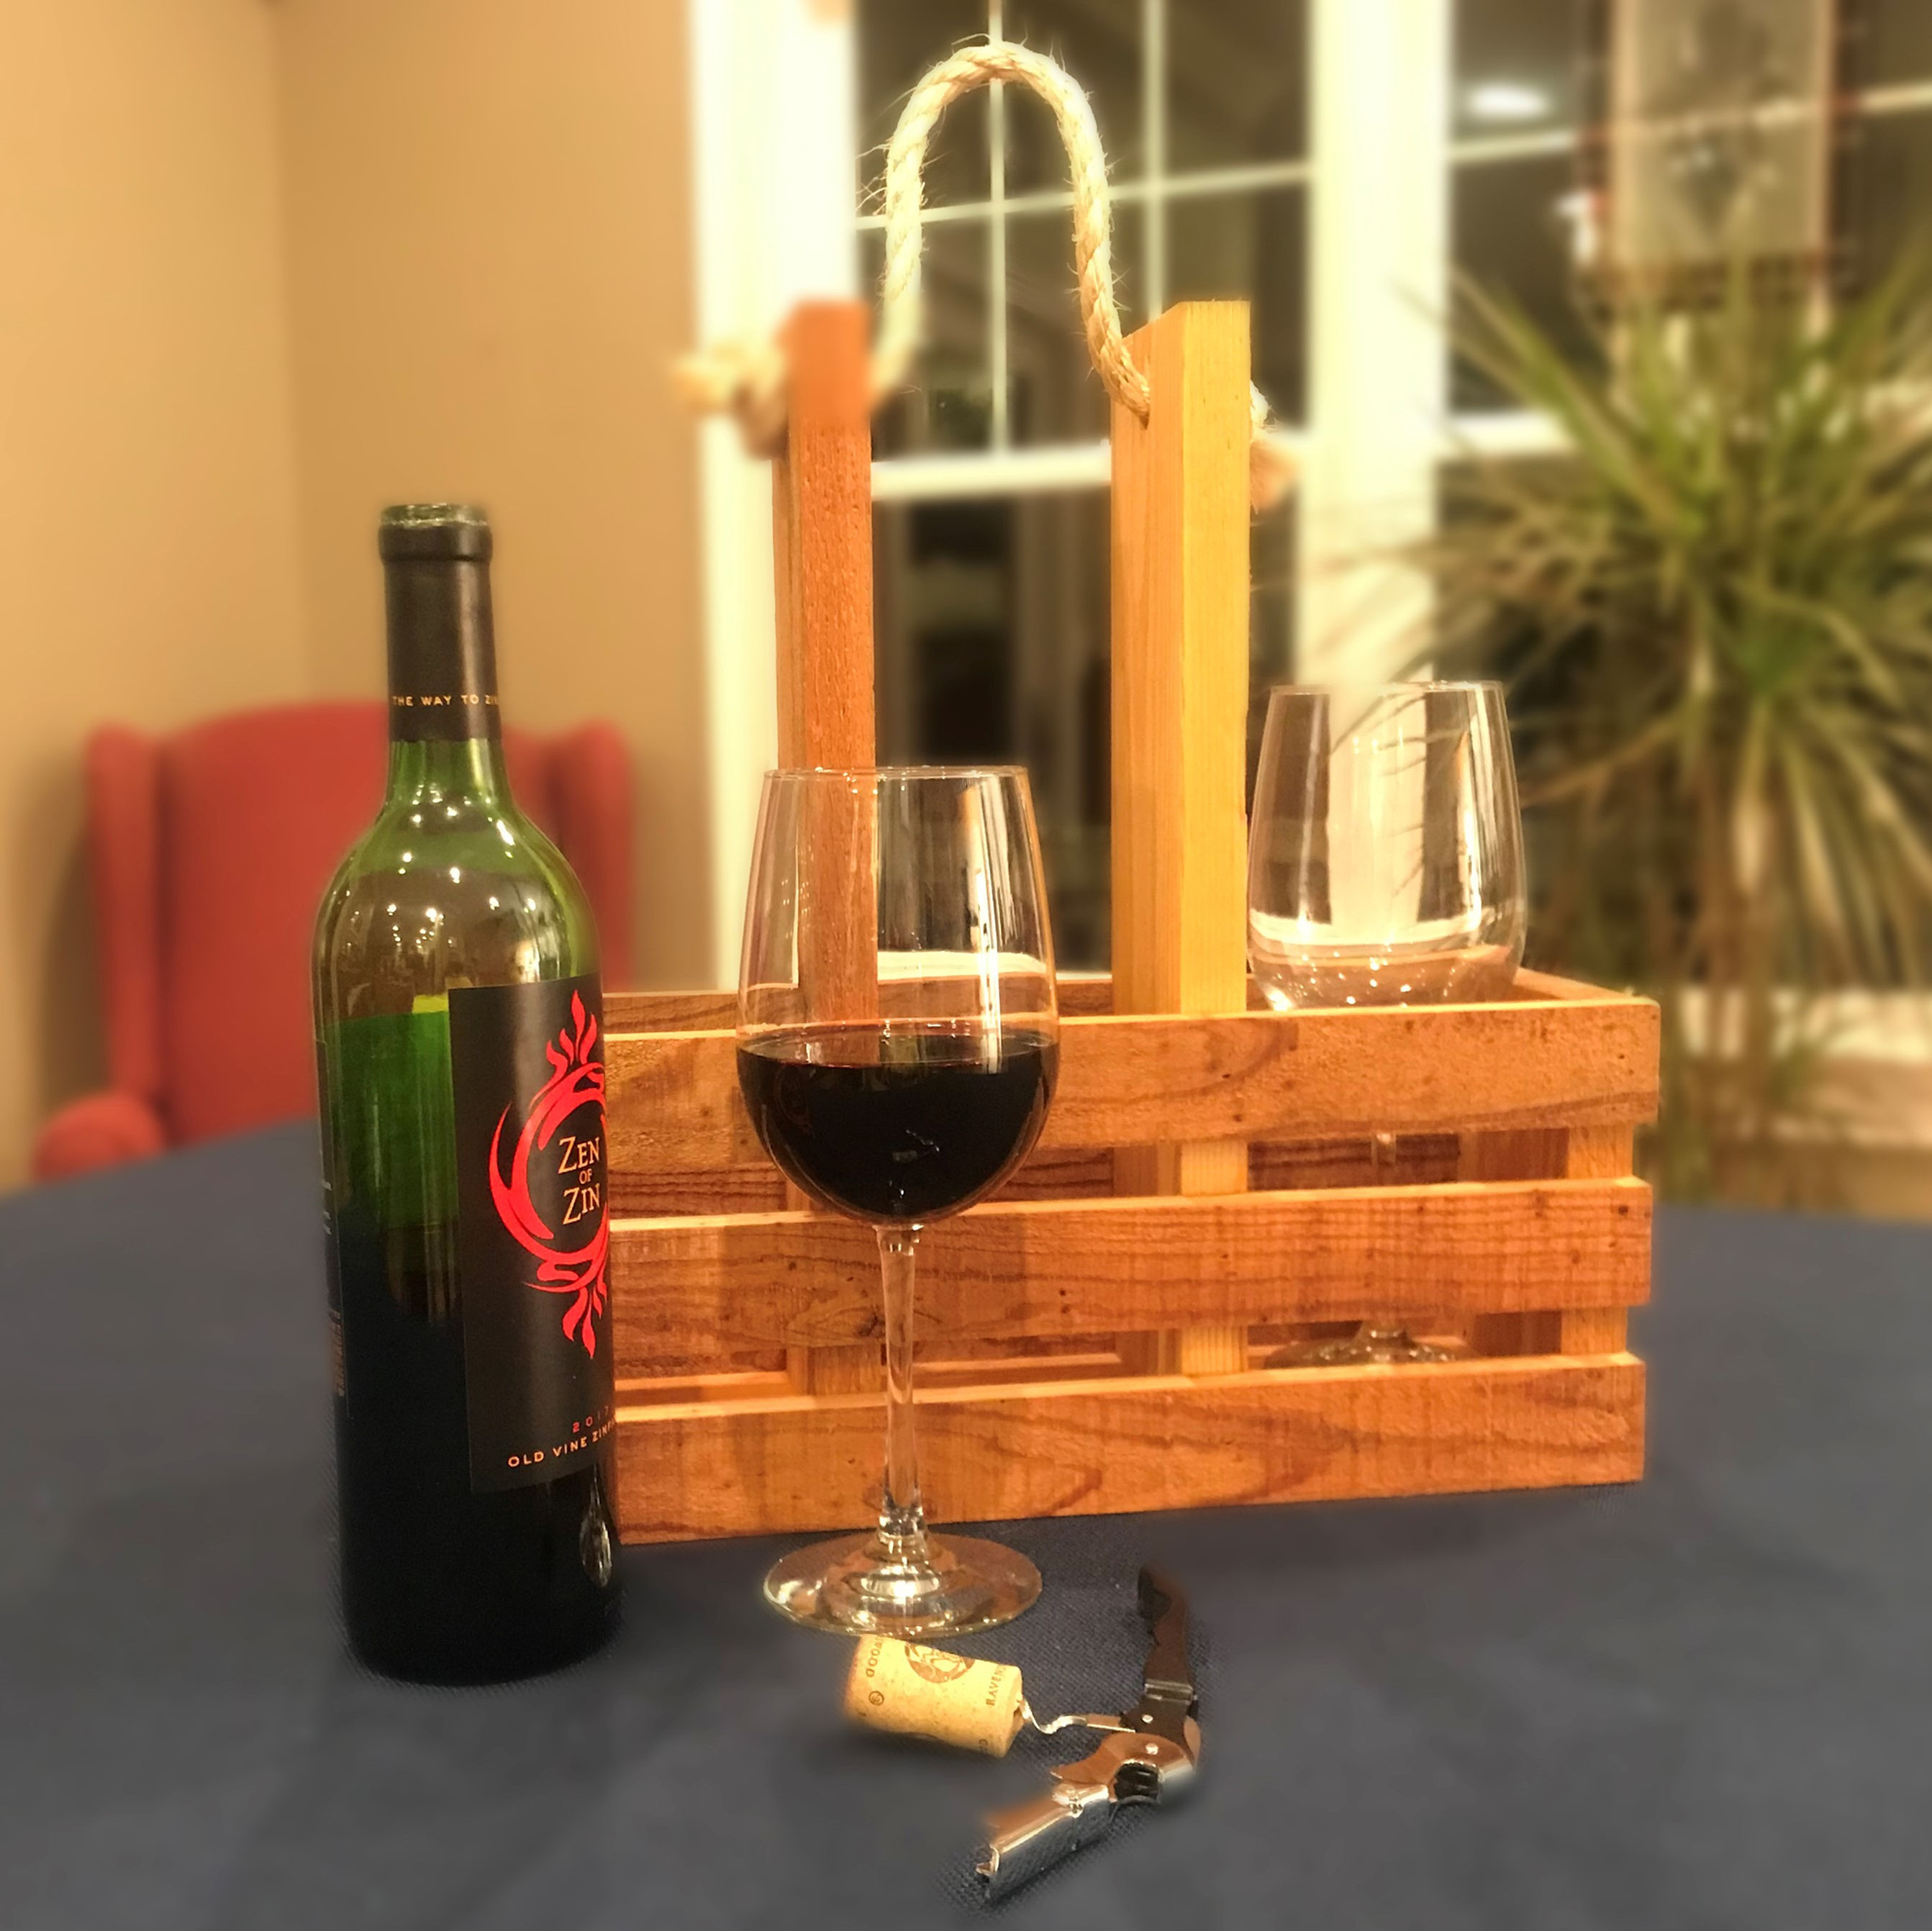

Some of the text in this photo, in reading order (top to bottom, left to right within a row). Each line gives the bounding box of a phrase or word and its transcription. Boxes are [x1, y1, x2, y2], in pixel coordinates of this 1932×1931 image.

[393, 696, 414, 706] THE
[420, 695, 452, 706] WAY
[461, 694, 479, 705] TO
[558, 1135, 600, 1174] ZEN
[579, 1168, 592, 1184] OF
[563, 1183, 600, 1225] ZIN
[508, 1451, 544, 1468] OLD
[553, 1436, 588, 1457] VINE
